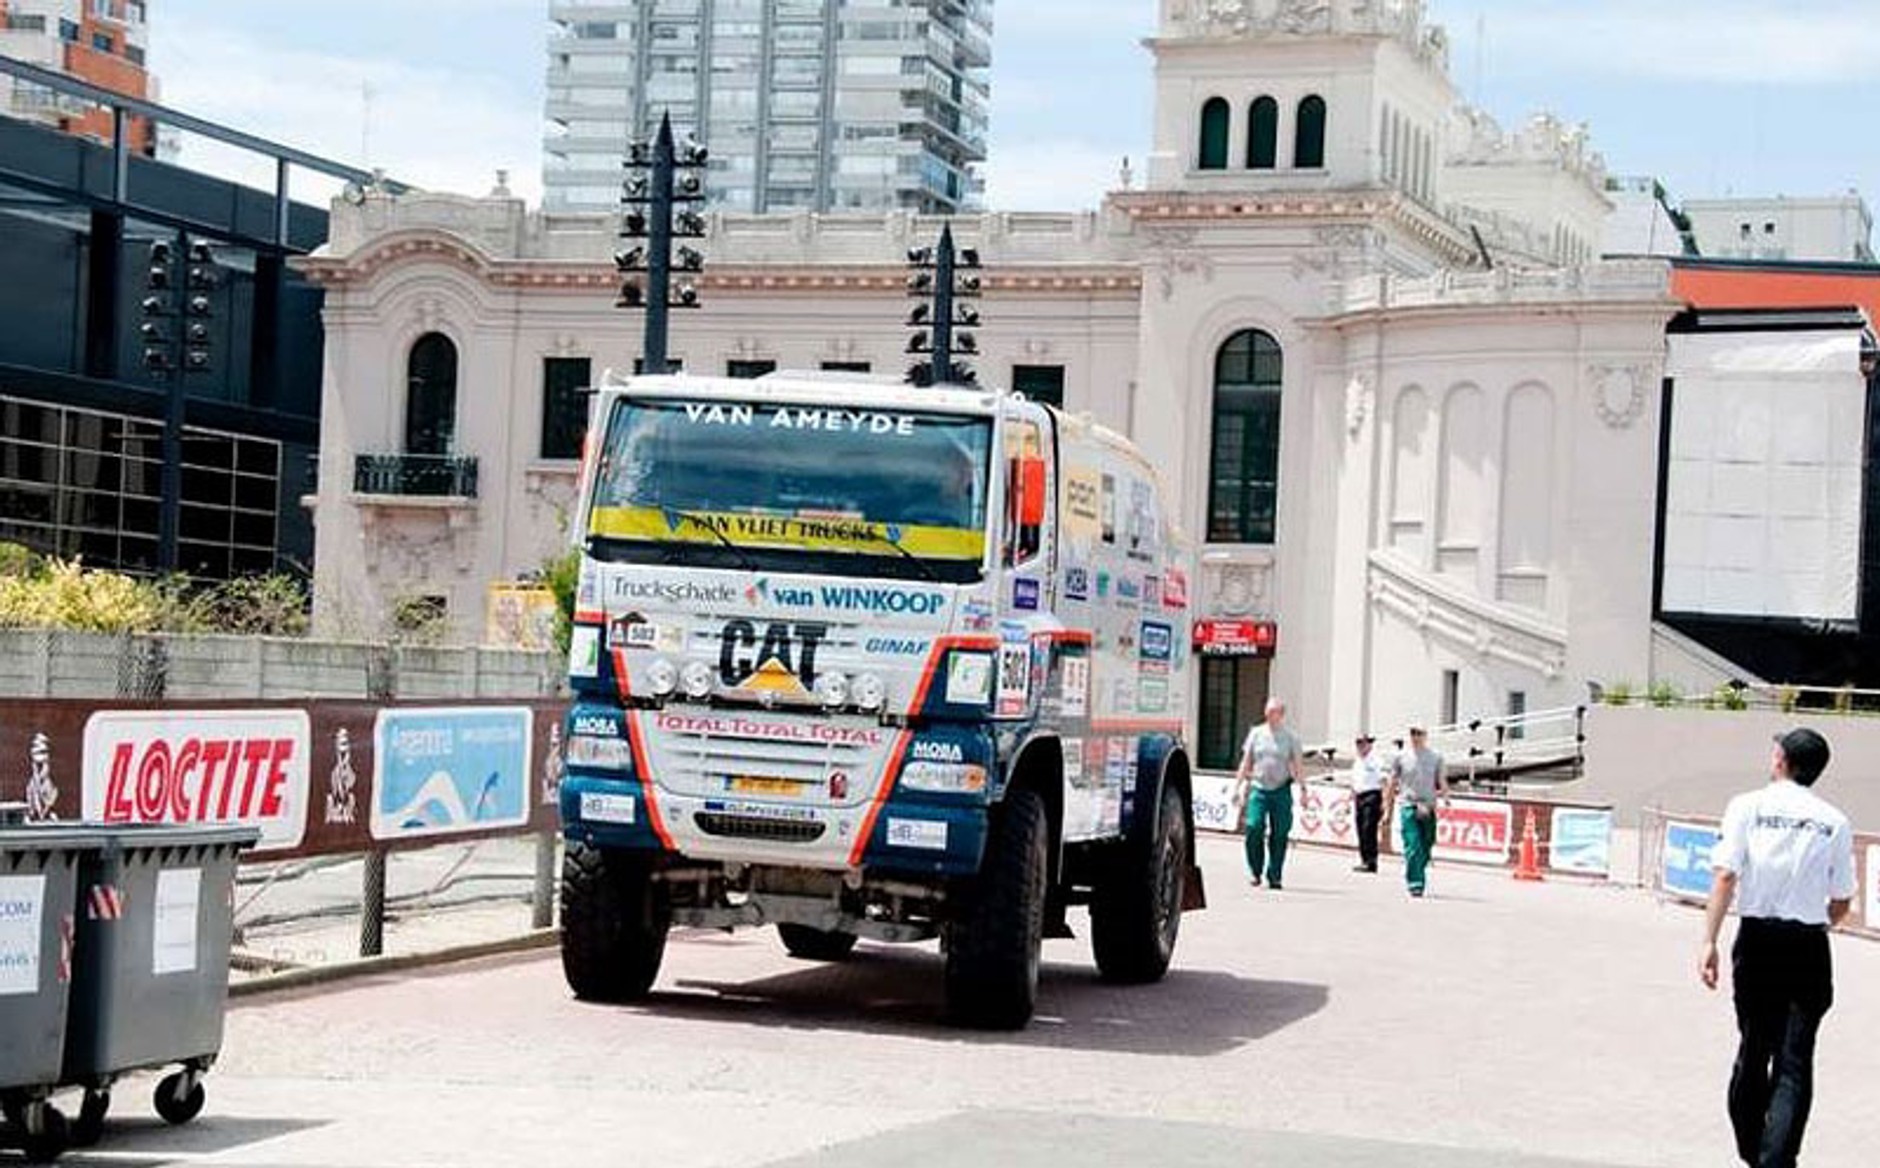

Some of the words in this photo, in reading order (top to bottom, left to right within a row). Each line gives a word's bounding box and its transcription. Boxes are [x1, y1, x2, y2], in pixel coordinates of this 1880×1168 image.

[685, 404, 753, 425] VAN
[769, 407, 914, 436] AMEYDE
[736, 517, 788, 537] VLIET
[613, 577, 737, 602] Truckschade
[773, 590, 815, 607] van
[820, 587, 945, 614] WINKOOP
[719, 619, 828, 691] CAT
[655, 713, 727, 732] TOTAL
[730, 719, 802, 738] TOTAL
[809, 723, 881, 743] TOTAL
[103, 739, 293, 823] LOCTITE
[1433, 819, 1497, 848] OTAL
[0, 902, 32, 917] OM
